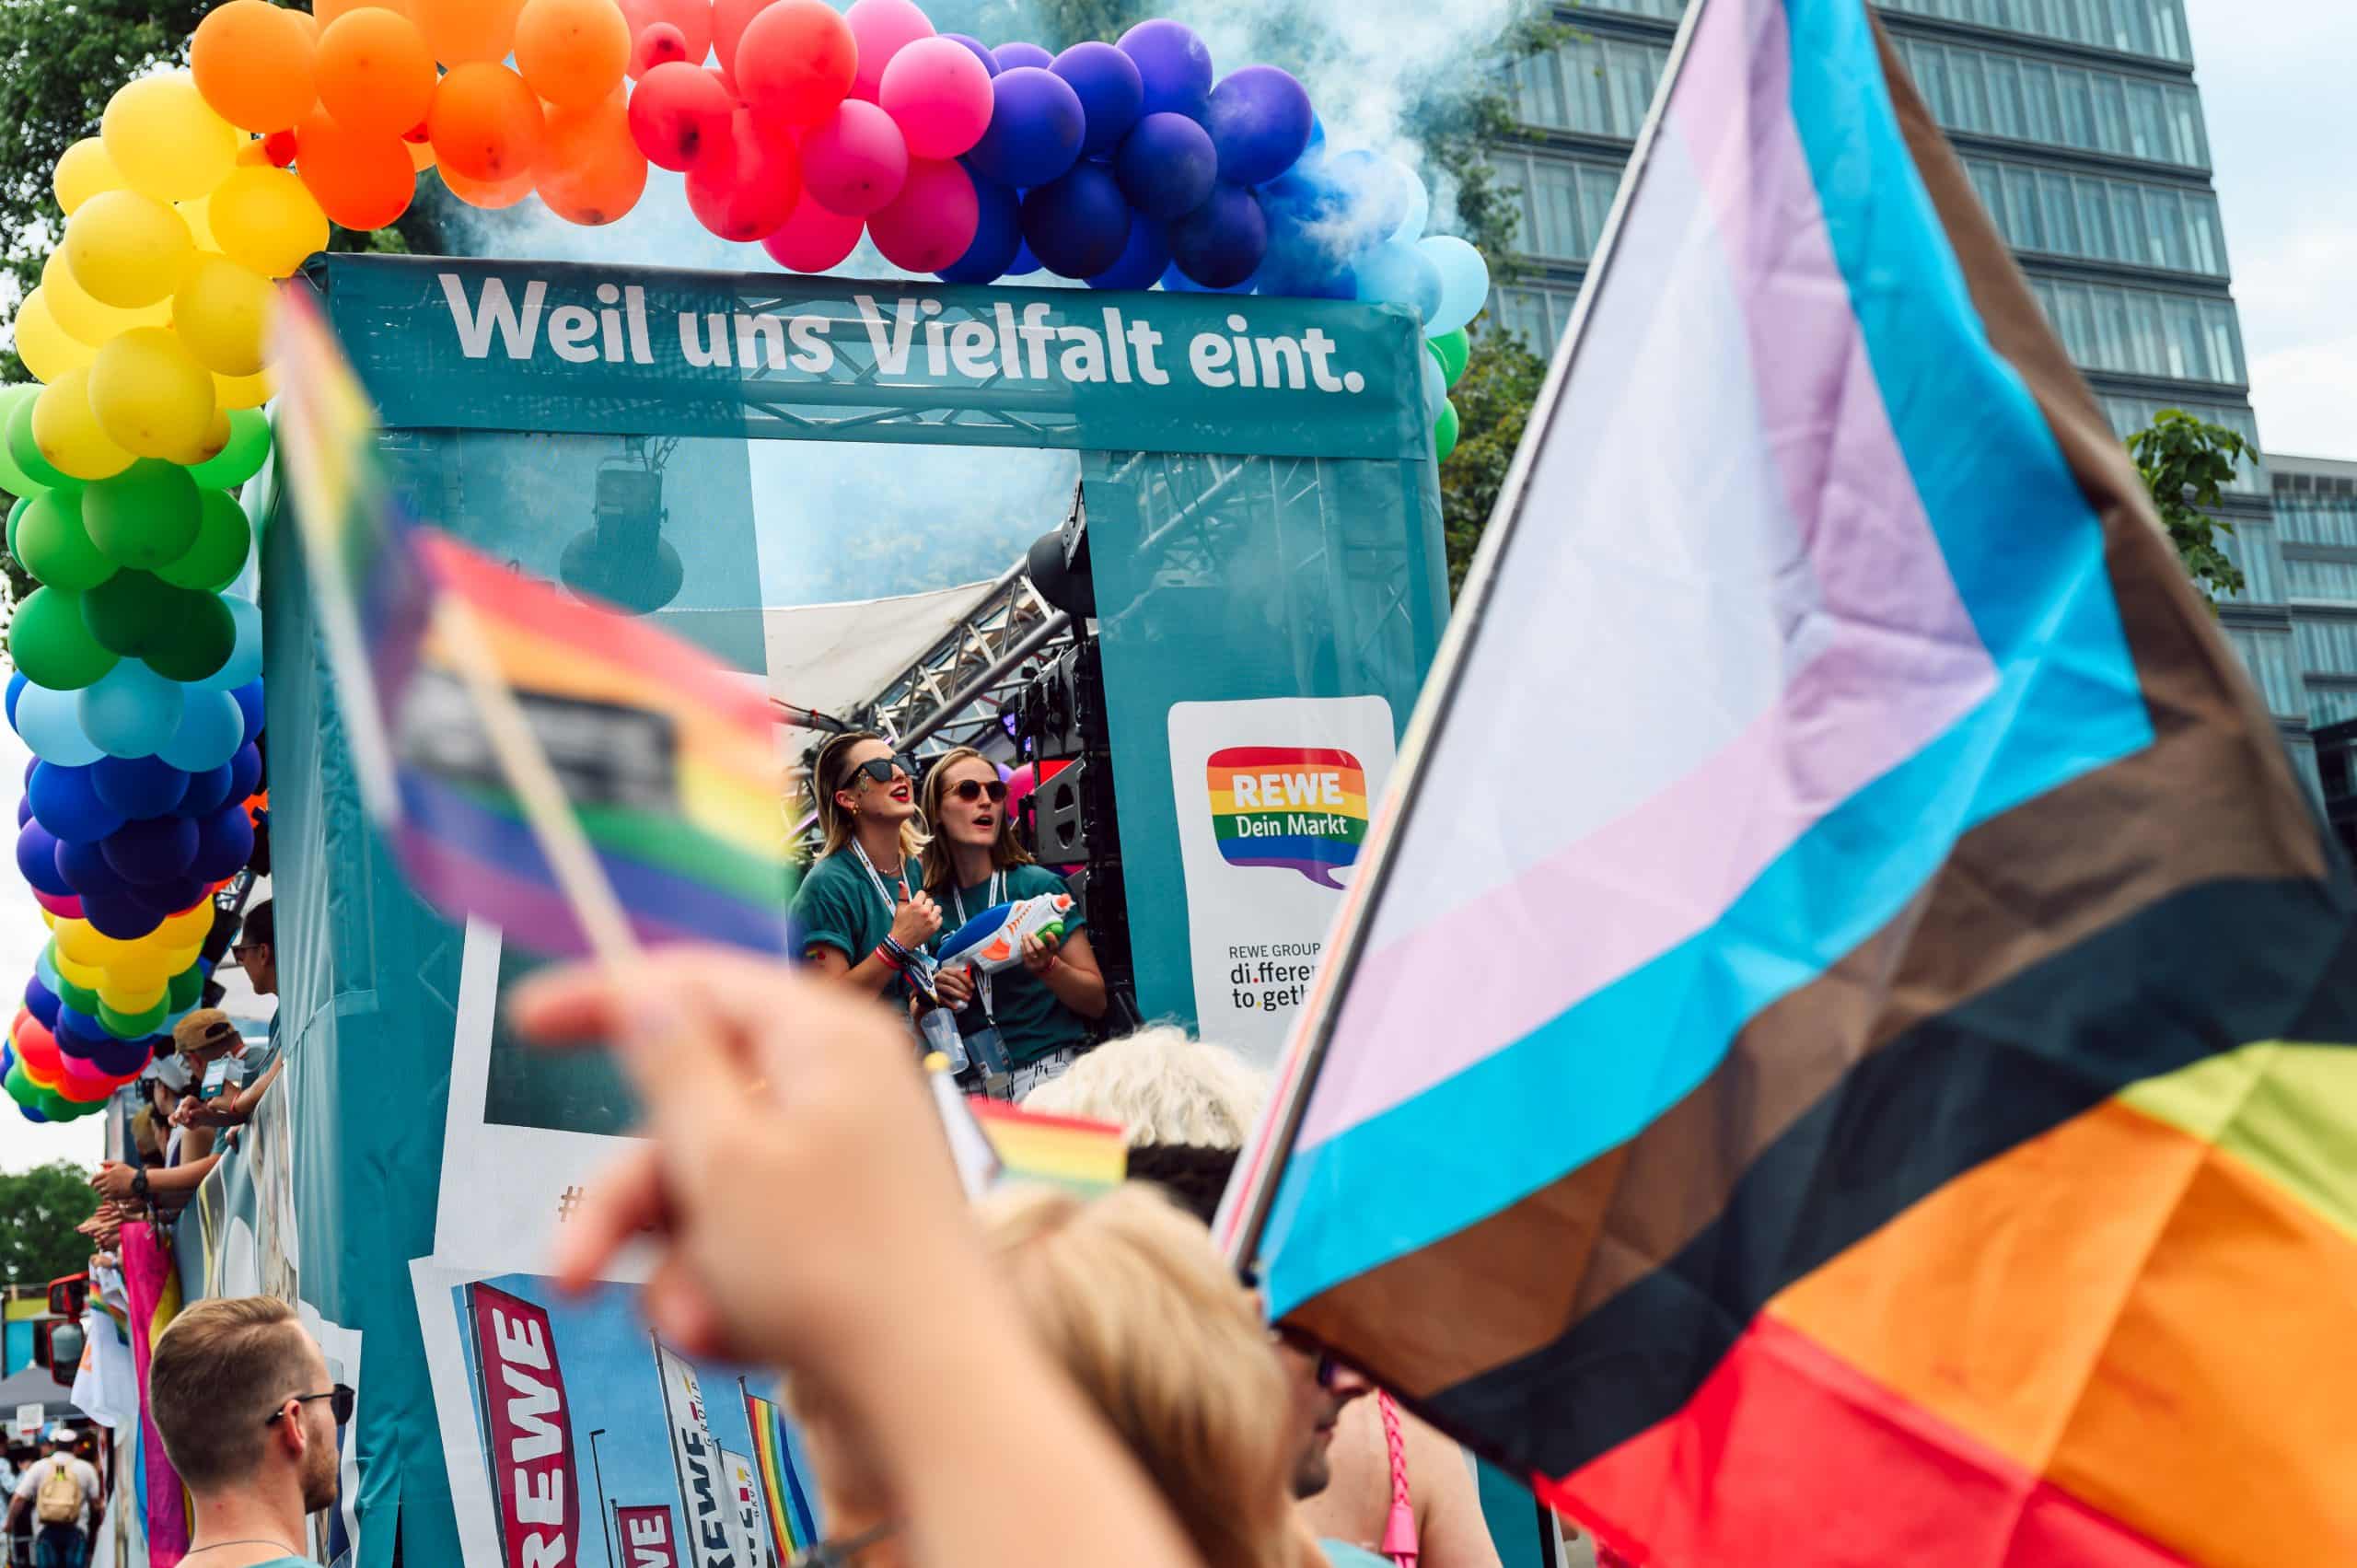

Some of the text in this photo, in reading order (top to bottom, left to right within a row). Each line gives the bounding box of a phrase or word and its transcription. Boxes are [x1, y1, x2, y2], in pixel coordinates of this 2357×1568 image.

[437, 273, 1365, 394] Weil uns Vielfalt eint.
[1232, 772, 1343, 808] REWE
[1236, 814, 1348, 840] Dein Markt
[1229, 942, 1321, 958] REWE GROUP
[492, 1307, 568, 1568] REWE
